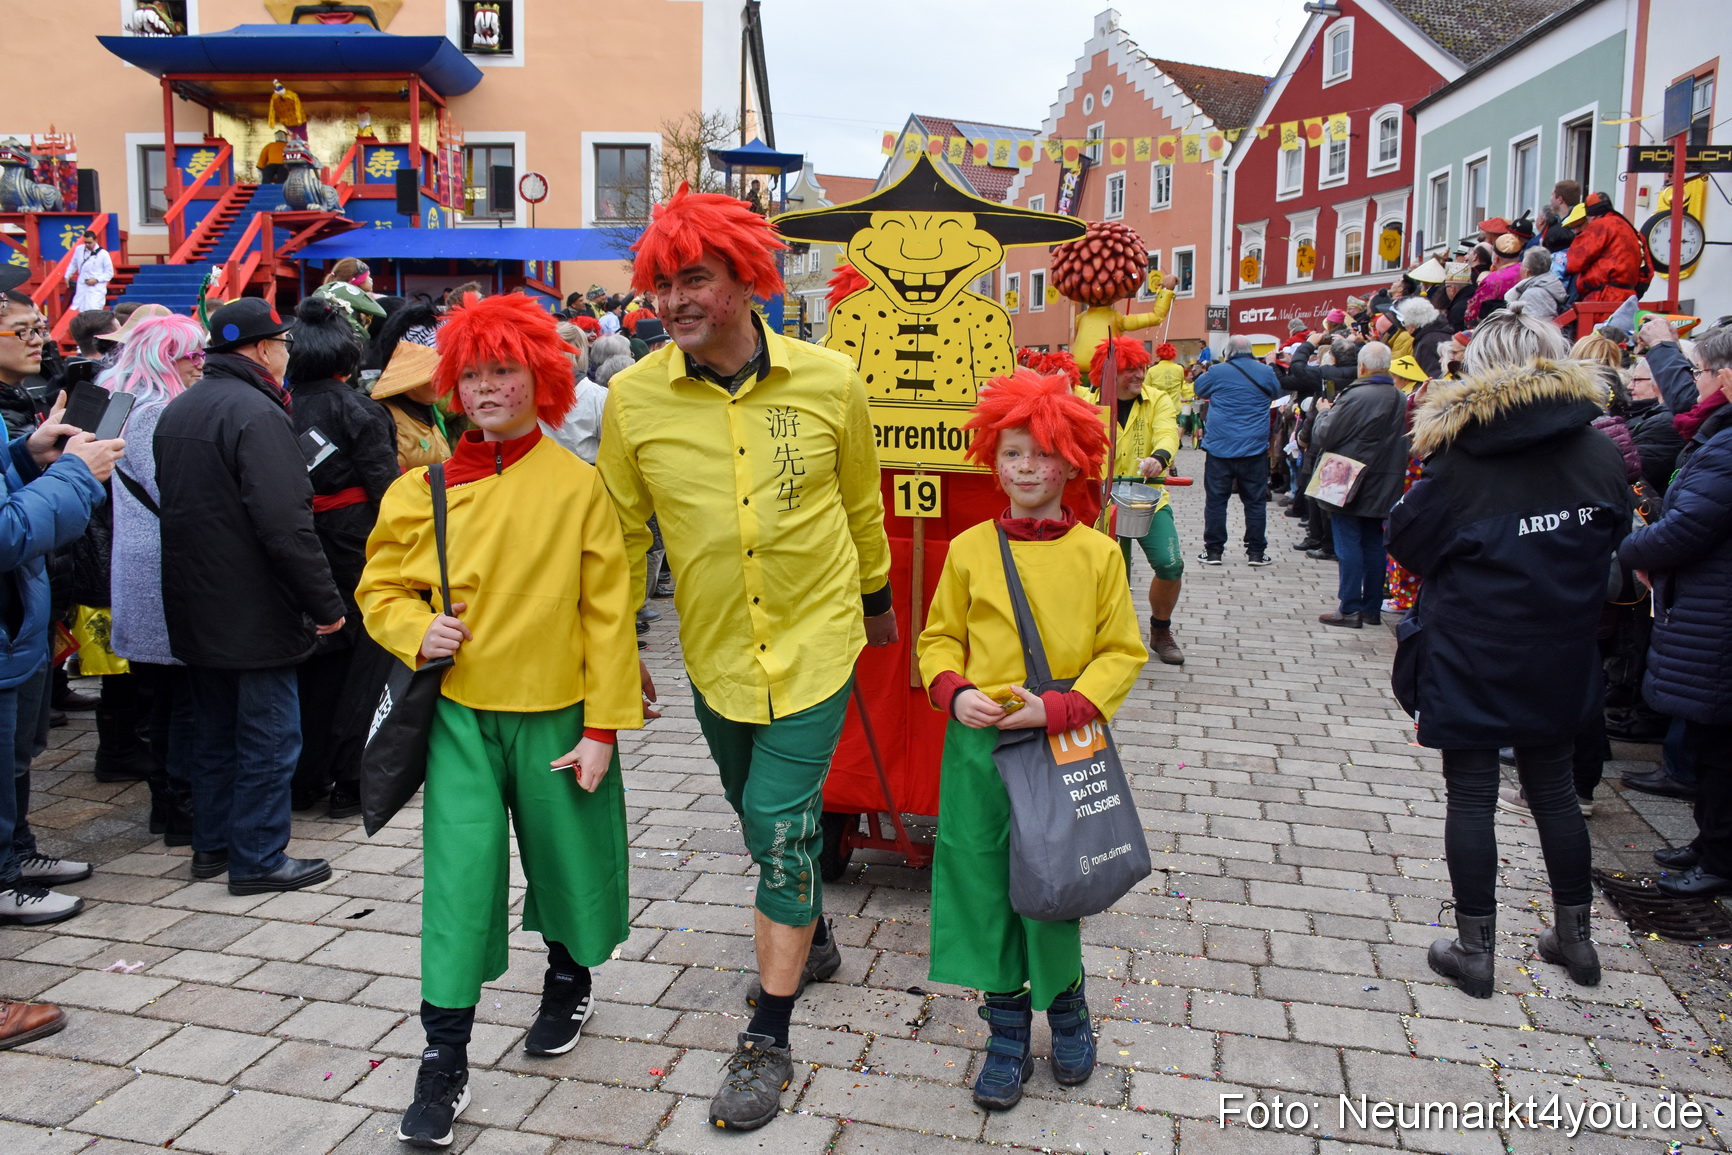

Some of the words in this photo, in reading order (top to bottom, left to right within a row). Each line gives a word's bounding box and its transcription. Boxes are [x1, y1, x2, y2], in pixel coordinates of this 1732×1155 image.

[1208, 308, 1227, 319] CAFÉ
[873, 421, 978, 451] errento
[765, 405, 806, 513] 游先生
[898, 481, 937, 512] 19
[1518, 513, 1560, 536] ARD
